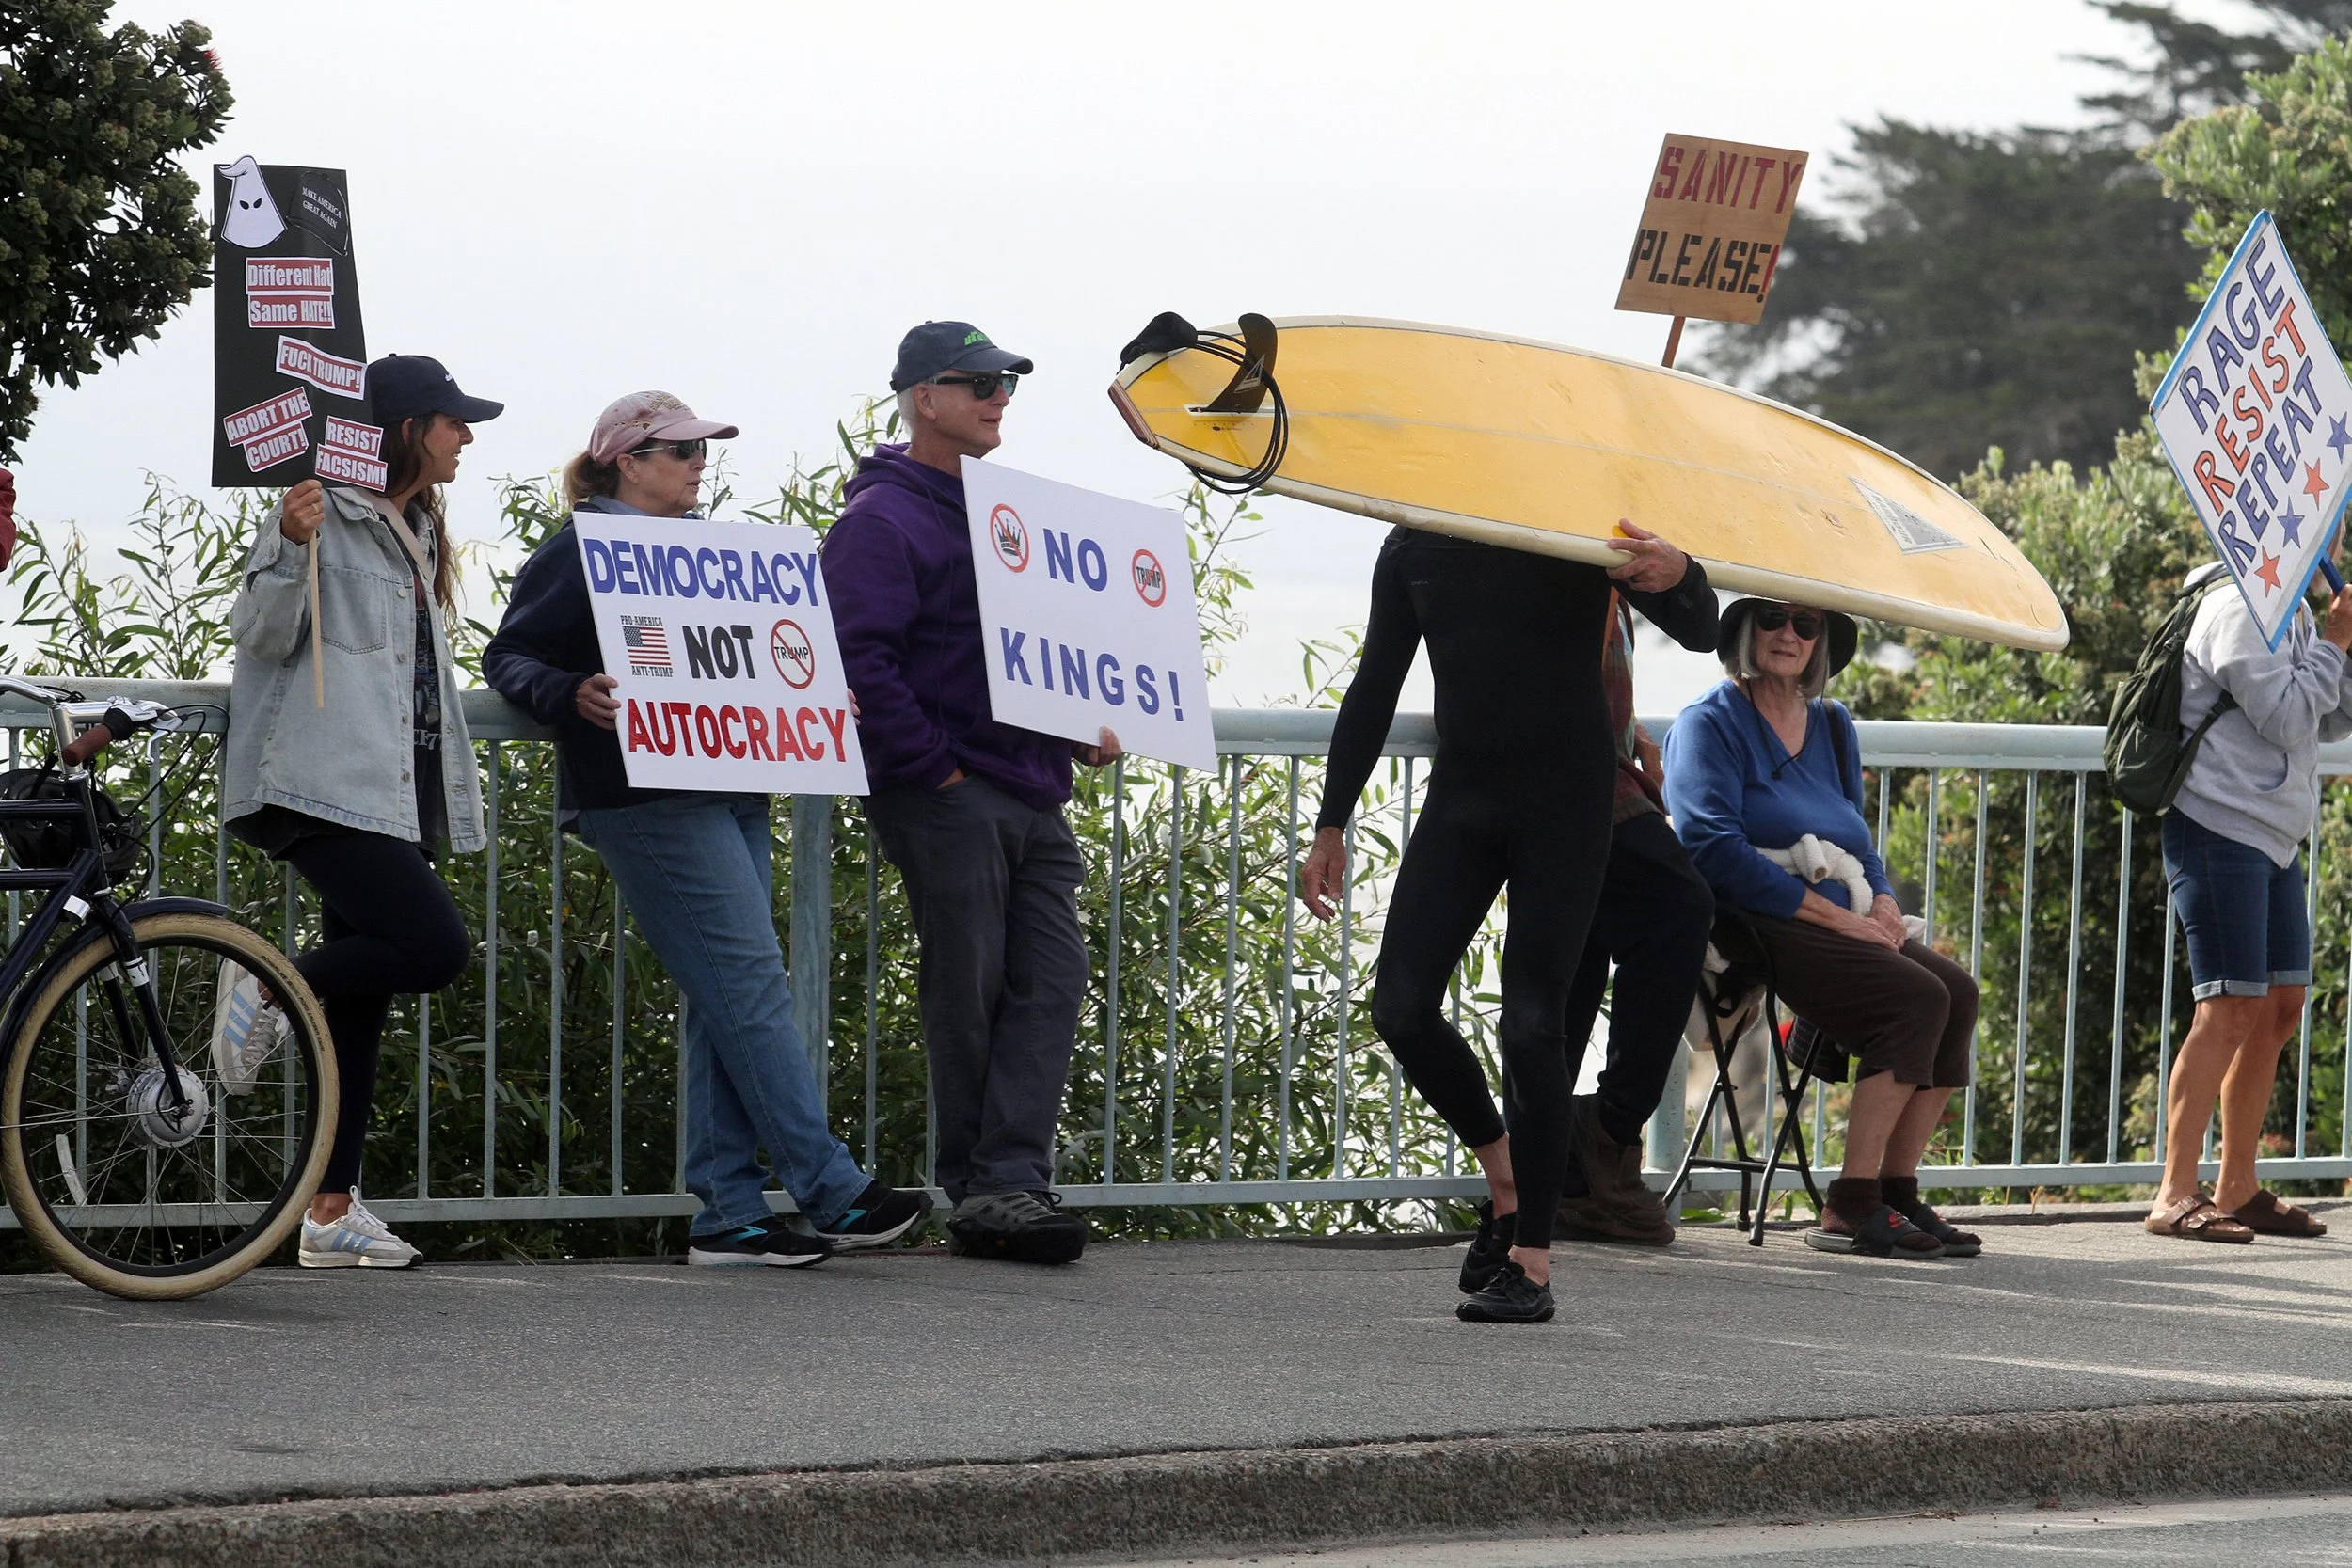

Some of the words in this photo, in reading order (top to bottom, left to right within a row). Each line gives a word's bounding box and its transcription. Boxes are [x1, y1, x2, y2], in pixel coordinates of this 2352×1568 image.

[302, 186, 317, 201] MAKE
[317, 196, 342, 219] AMERICA
[1653, 146, 1804, 214] SANITY
[302, 200, 320, 215] GREAT
[319, 211, 338, 229] AGAIN
[247, 264, 313, 287] Different
[1626, 228, 1780, 303] PLEASE!
[250, 300, 297, 323] Same
[2179, 237, 2285, 435] RAGE
[280, 345, 312, 373] FUCK
[313, 356, 361, 389] TRUMP!
[225, 404, 278, 442] ABORT
[278, 392, 310, 420] THE
[2193, 297, 2306, 516] RESIST
[246, 427, 307, 467] COURT!
[326, 421, 380, 452] RESIST
[316, 454, 386, 485] FACSISM!
[2218, 355, 2322, 578] REPEAT
[583, 538, 818, 607] DEMOCRACY
[1042, 528, 1108, 592] NO
[620, 614, 663, 627] PRO-AMERICA
[631, 665, 674, 678] ANTI-TRUMP
[681, 625, 756, 679] NOT
[773, 646, 809, 660] TRUMP
[999, 627, 1184, 721] KINGS!
[628, 698, 847, 763] AUTOCRACY
